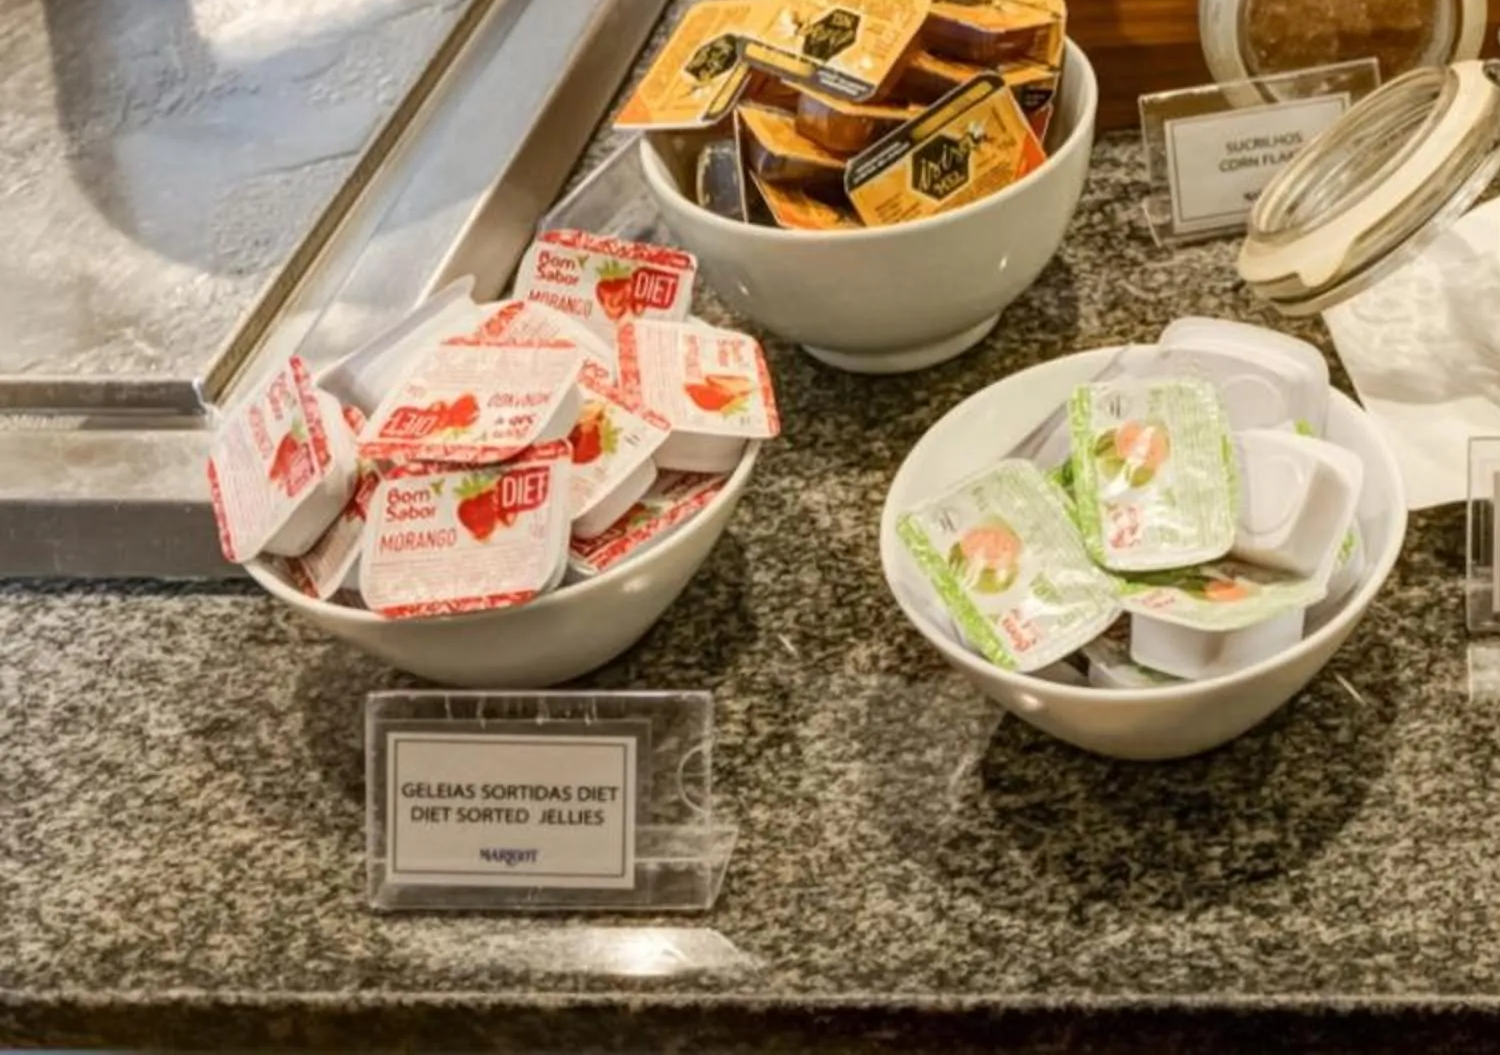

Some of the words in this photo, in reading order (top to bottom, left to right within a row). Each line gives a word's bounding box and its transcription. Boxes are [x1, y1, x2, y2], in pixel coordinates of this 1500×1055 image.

[1225, 131, 1303, 152] SUCRILHOS
[1219, 155, 1259, 172] CORN
[537, 249, 577, 270] Bom
[633, 270, 677, 305] DIET
[387, 486, 431, 504] Bom
[502, 472, 548, 508] DIET
[385, 504, 437, 522] Sabor
[379, 528, 457, 553] MORANGO
[401, 782, 476, 800] GELEIAS
[480, 783, 573, 802] SORTIDAS
[577, 786, 619, 803] DIET
[410, 806, 452, 823] DIET
[456, 806, 530, 825] SORTED
[538, 808, 605, 826] JELLIES
